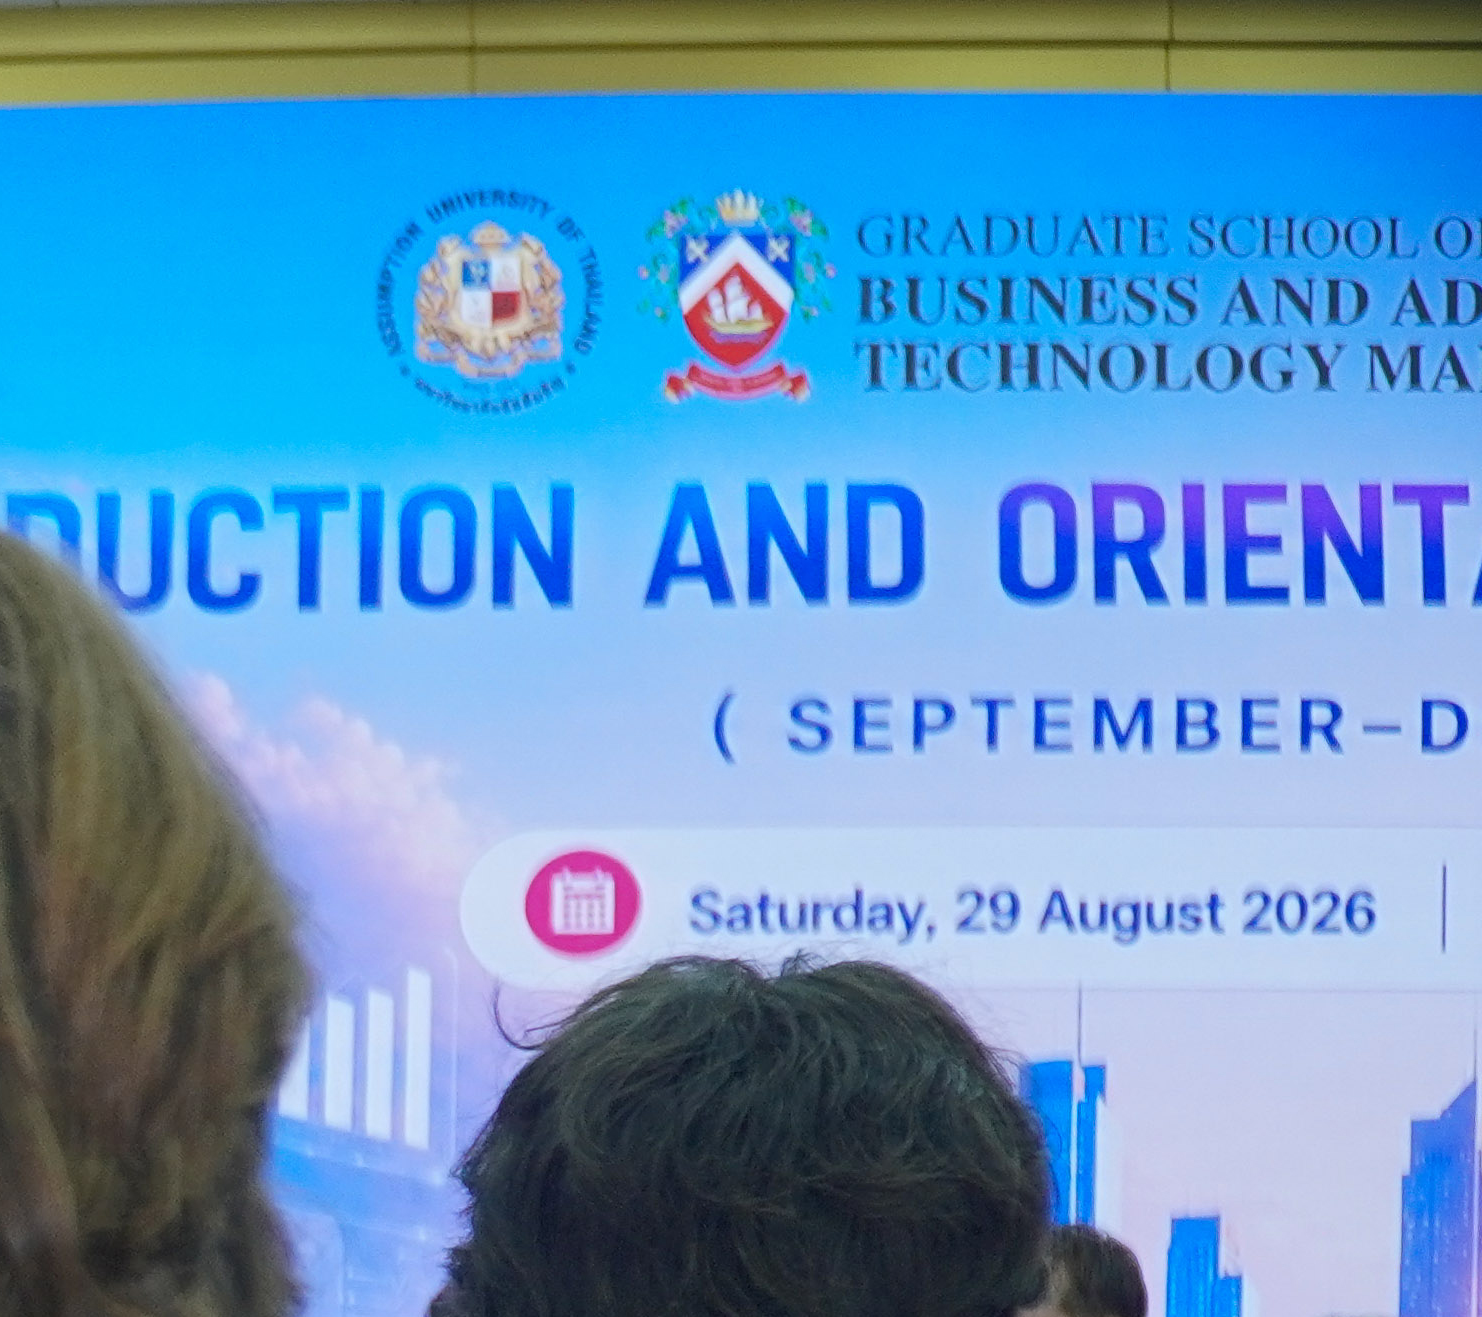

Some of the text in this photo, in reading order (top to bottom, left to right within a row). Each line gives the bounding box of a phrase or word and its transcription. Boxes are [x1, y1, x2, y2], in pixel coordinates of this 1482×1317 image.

[857, 214, 1482, 259] GRADUATE SCHOOL O
[858, 276, 1198, 327] BUSINESS
[1220, 276, 1370, 327] AND
[856, 342, 1482, 394] TECHNOLOGY MA
[643, 481, 926, 606] AND
[997, 481, 1482, 607] ORIENT
[690, 885, 1377, 944] Saturday, 29 August 2026
